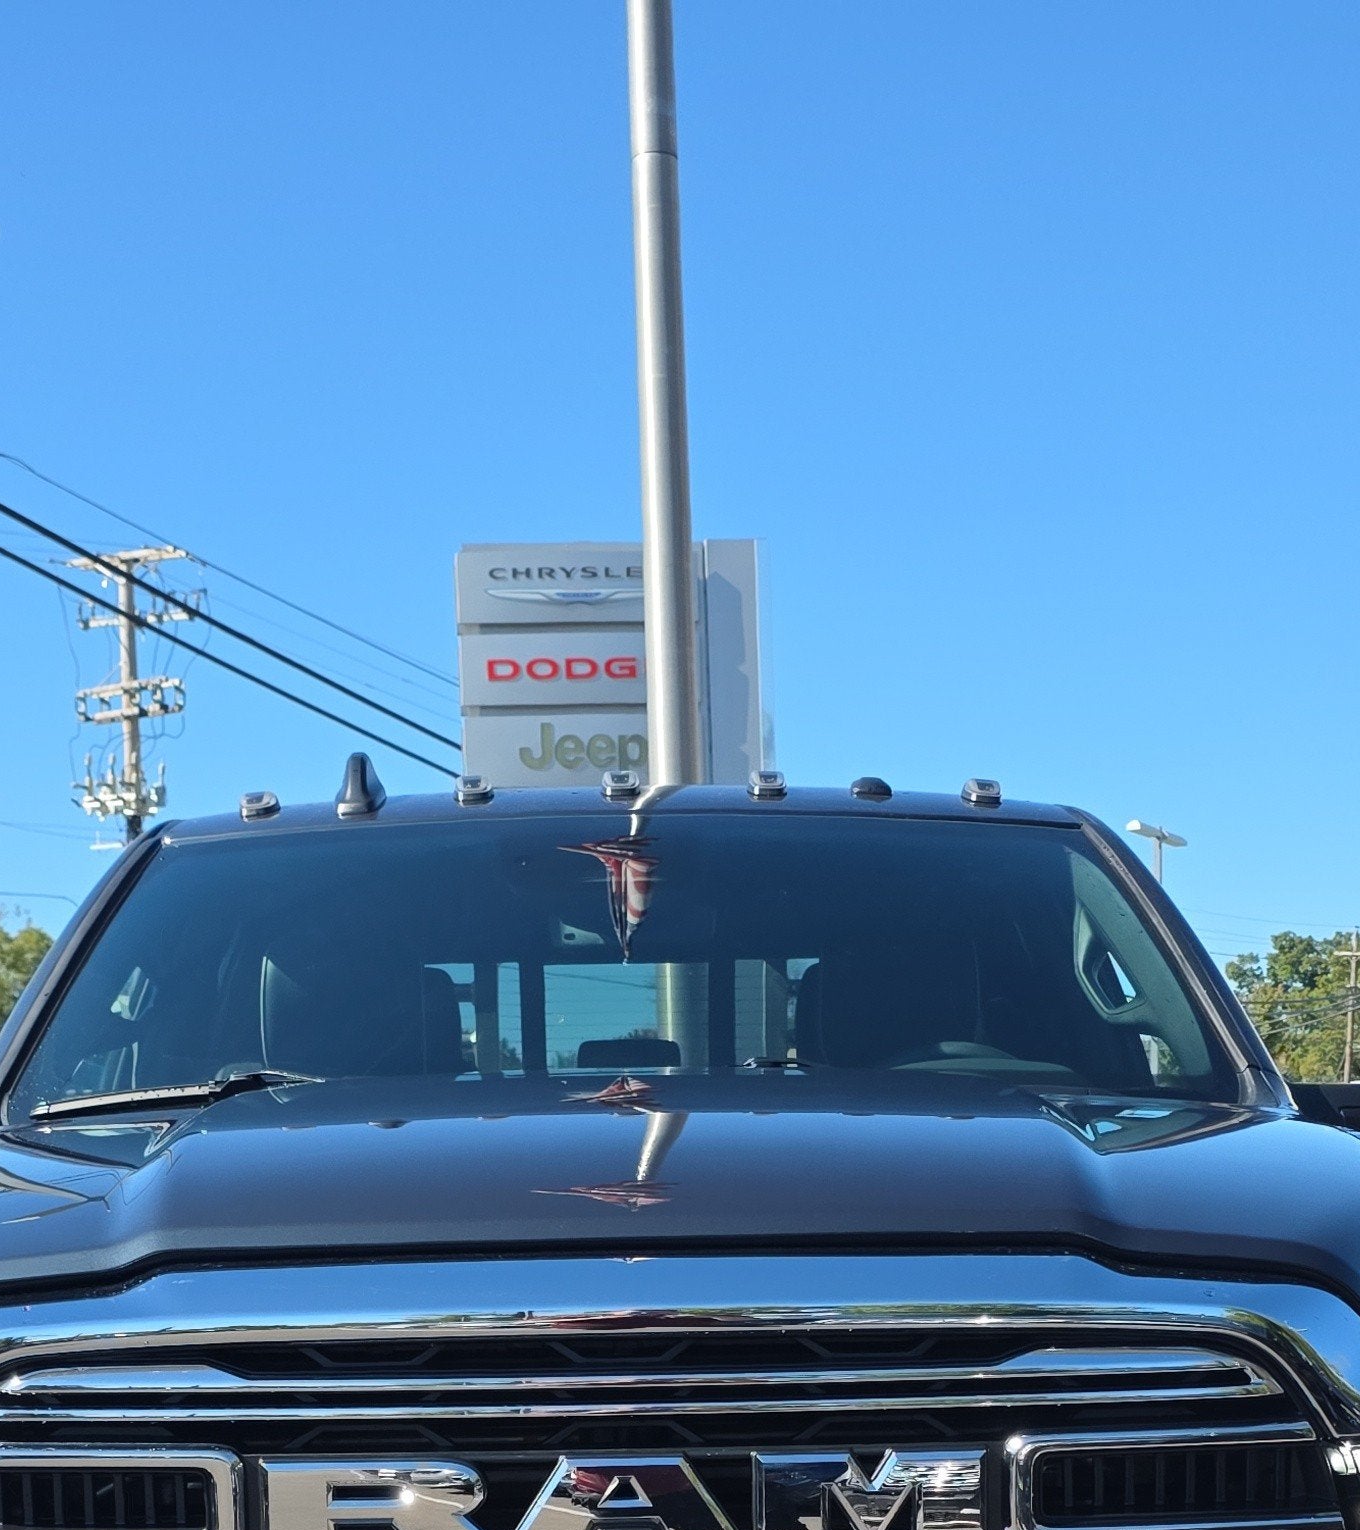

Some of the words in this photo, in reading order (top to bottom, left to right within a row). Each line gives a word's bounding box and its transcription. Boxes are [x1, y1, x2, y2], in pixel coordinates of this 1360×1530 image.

[488, 565, 643, 581] CHRYSLE
[486, 656, 639, 683] DODG
[518, 721, 649, 772] Jeep
